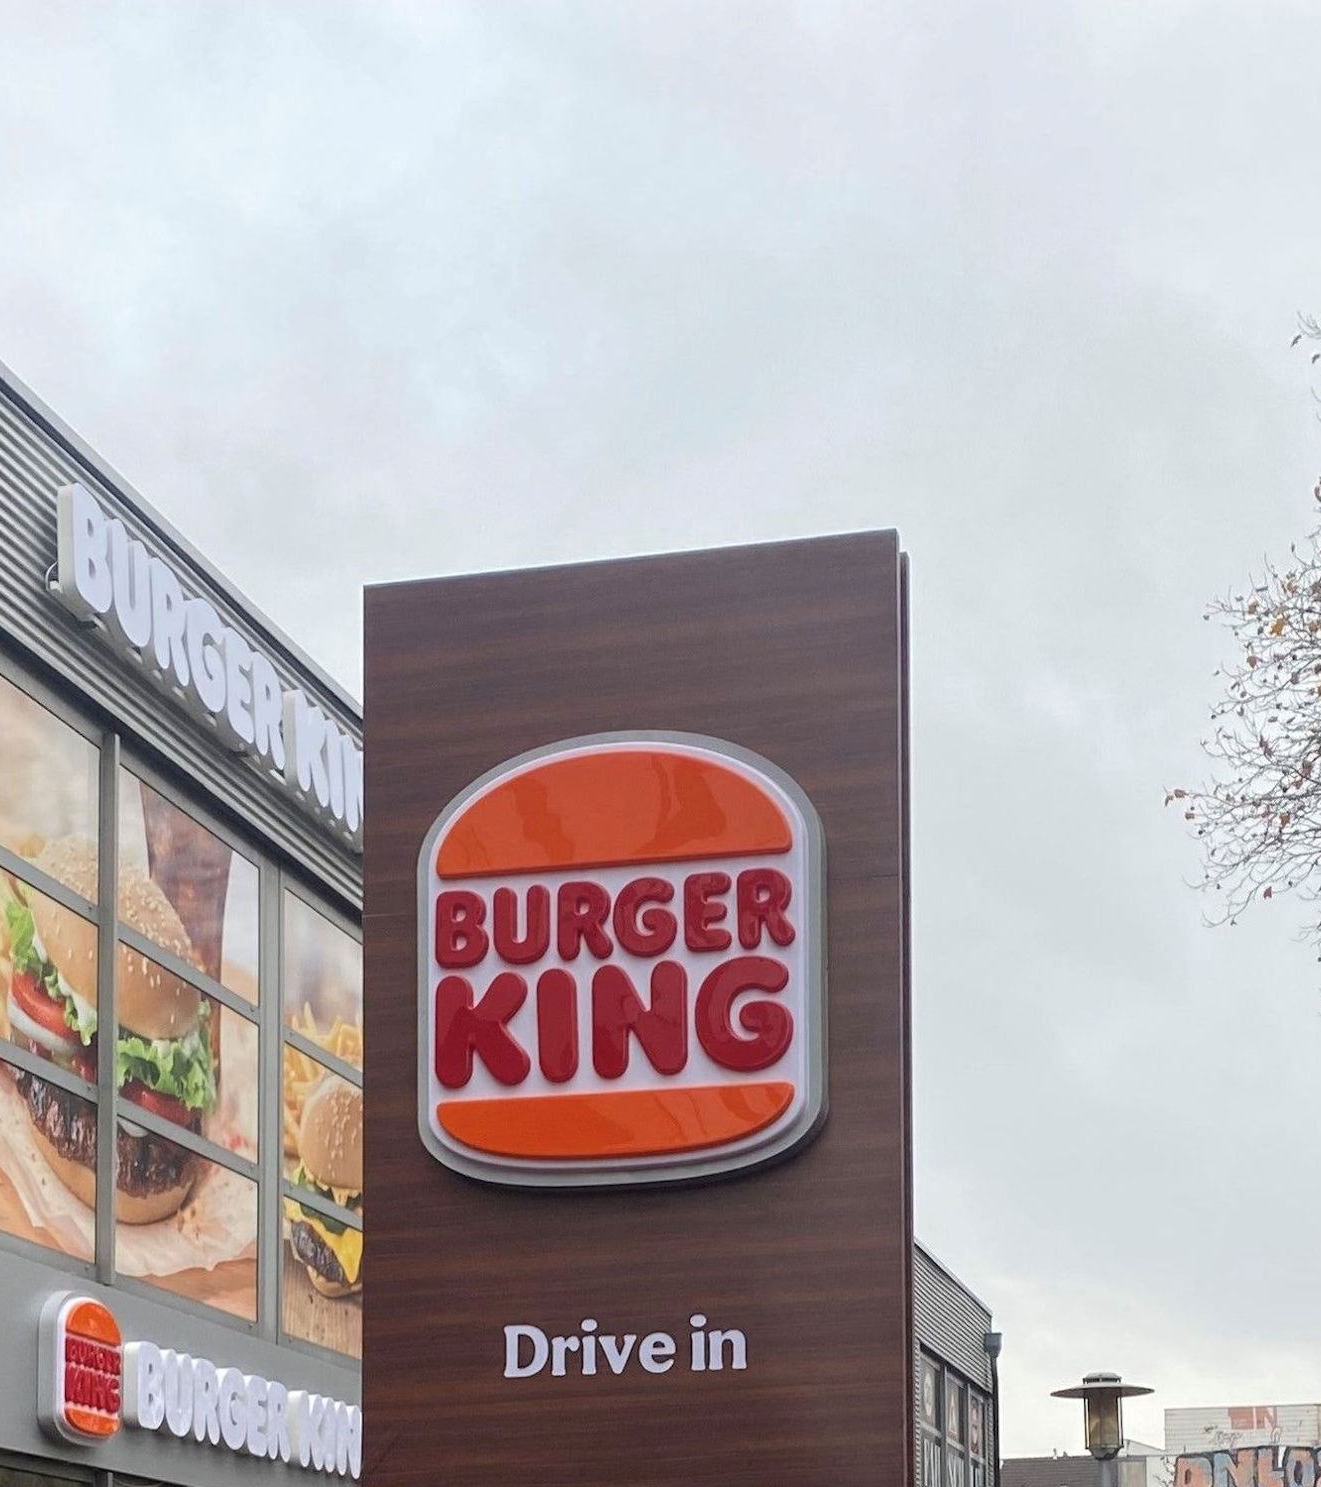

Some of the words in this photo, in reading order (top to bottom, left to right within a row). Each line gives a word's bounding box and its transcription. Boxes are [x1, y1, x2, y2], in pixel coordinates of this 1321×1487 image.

[58, 483, 286, 772] BURGER
[434, 867, 797, 970] BURGER
[434, 955, 795, 1090] KING
[125, 1340, 291, 1463] BURGER
[502, 1317, 676, 1379] Drive
[688, 1313, 749, 1372] in
